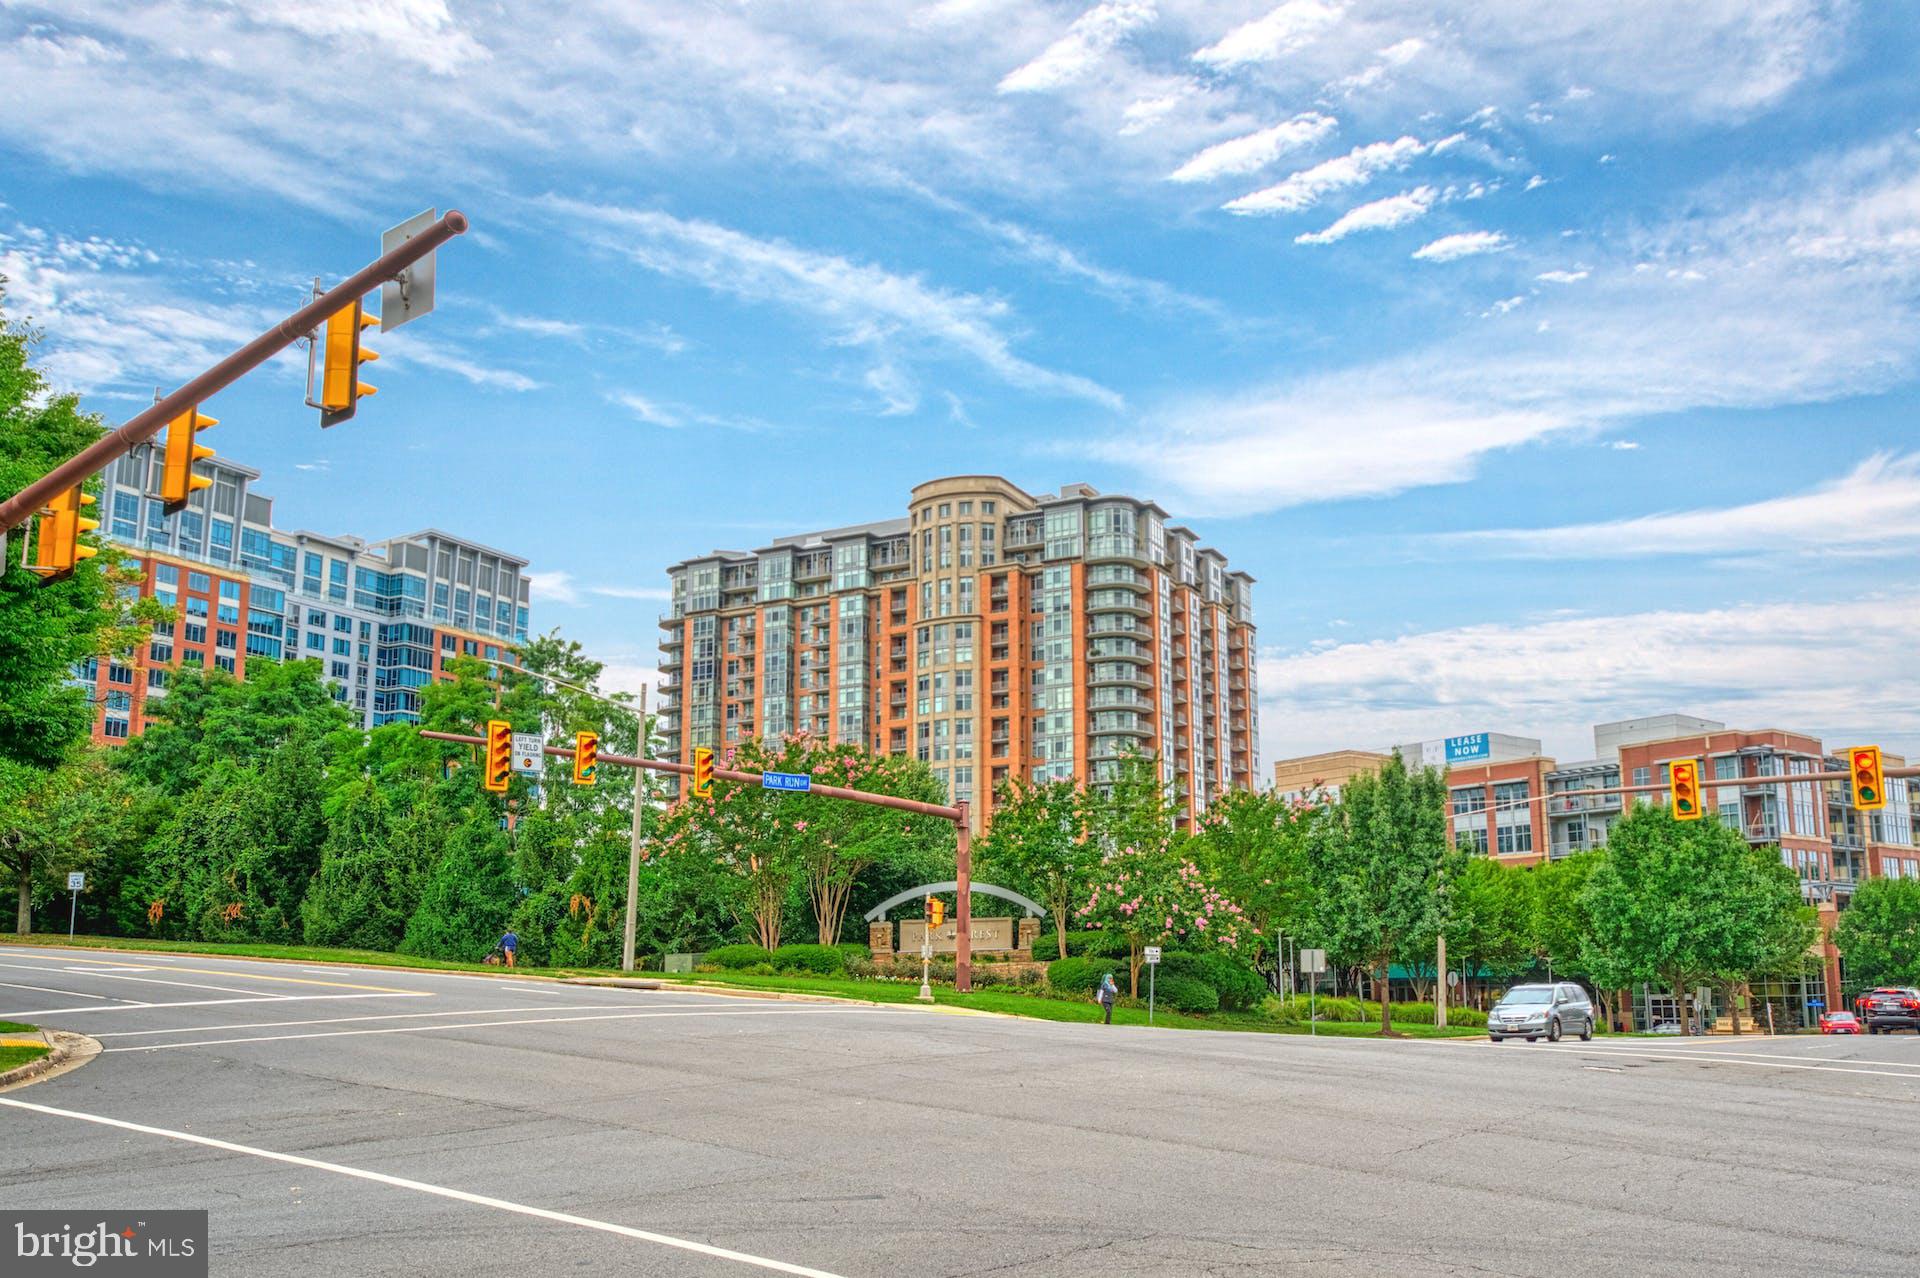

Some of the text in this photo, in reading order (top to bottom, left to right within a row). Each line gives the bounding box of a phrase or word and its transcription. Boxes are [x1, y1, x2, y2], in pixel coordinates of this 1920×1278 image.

[1451, 735, 1482, 747] LEASE
[518, 743, 539, 752] YIELD
[1454, 745, 1480, 756] NOW
[765, 774, 782, 787] PARK
[784, 776, 800, 788] RUN
[70, 880, 81, 888] 35
[970, 928, 1000, 941] REST
